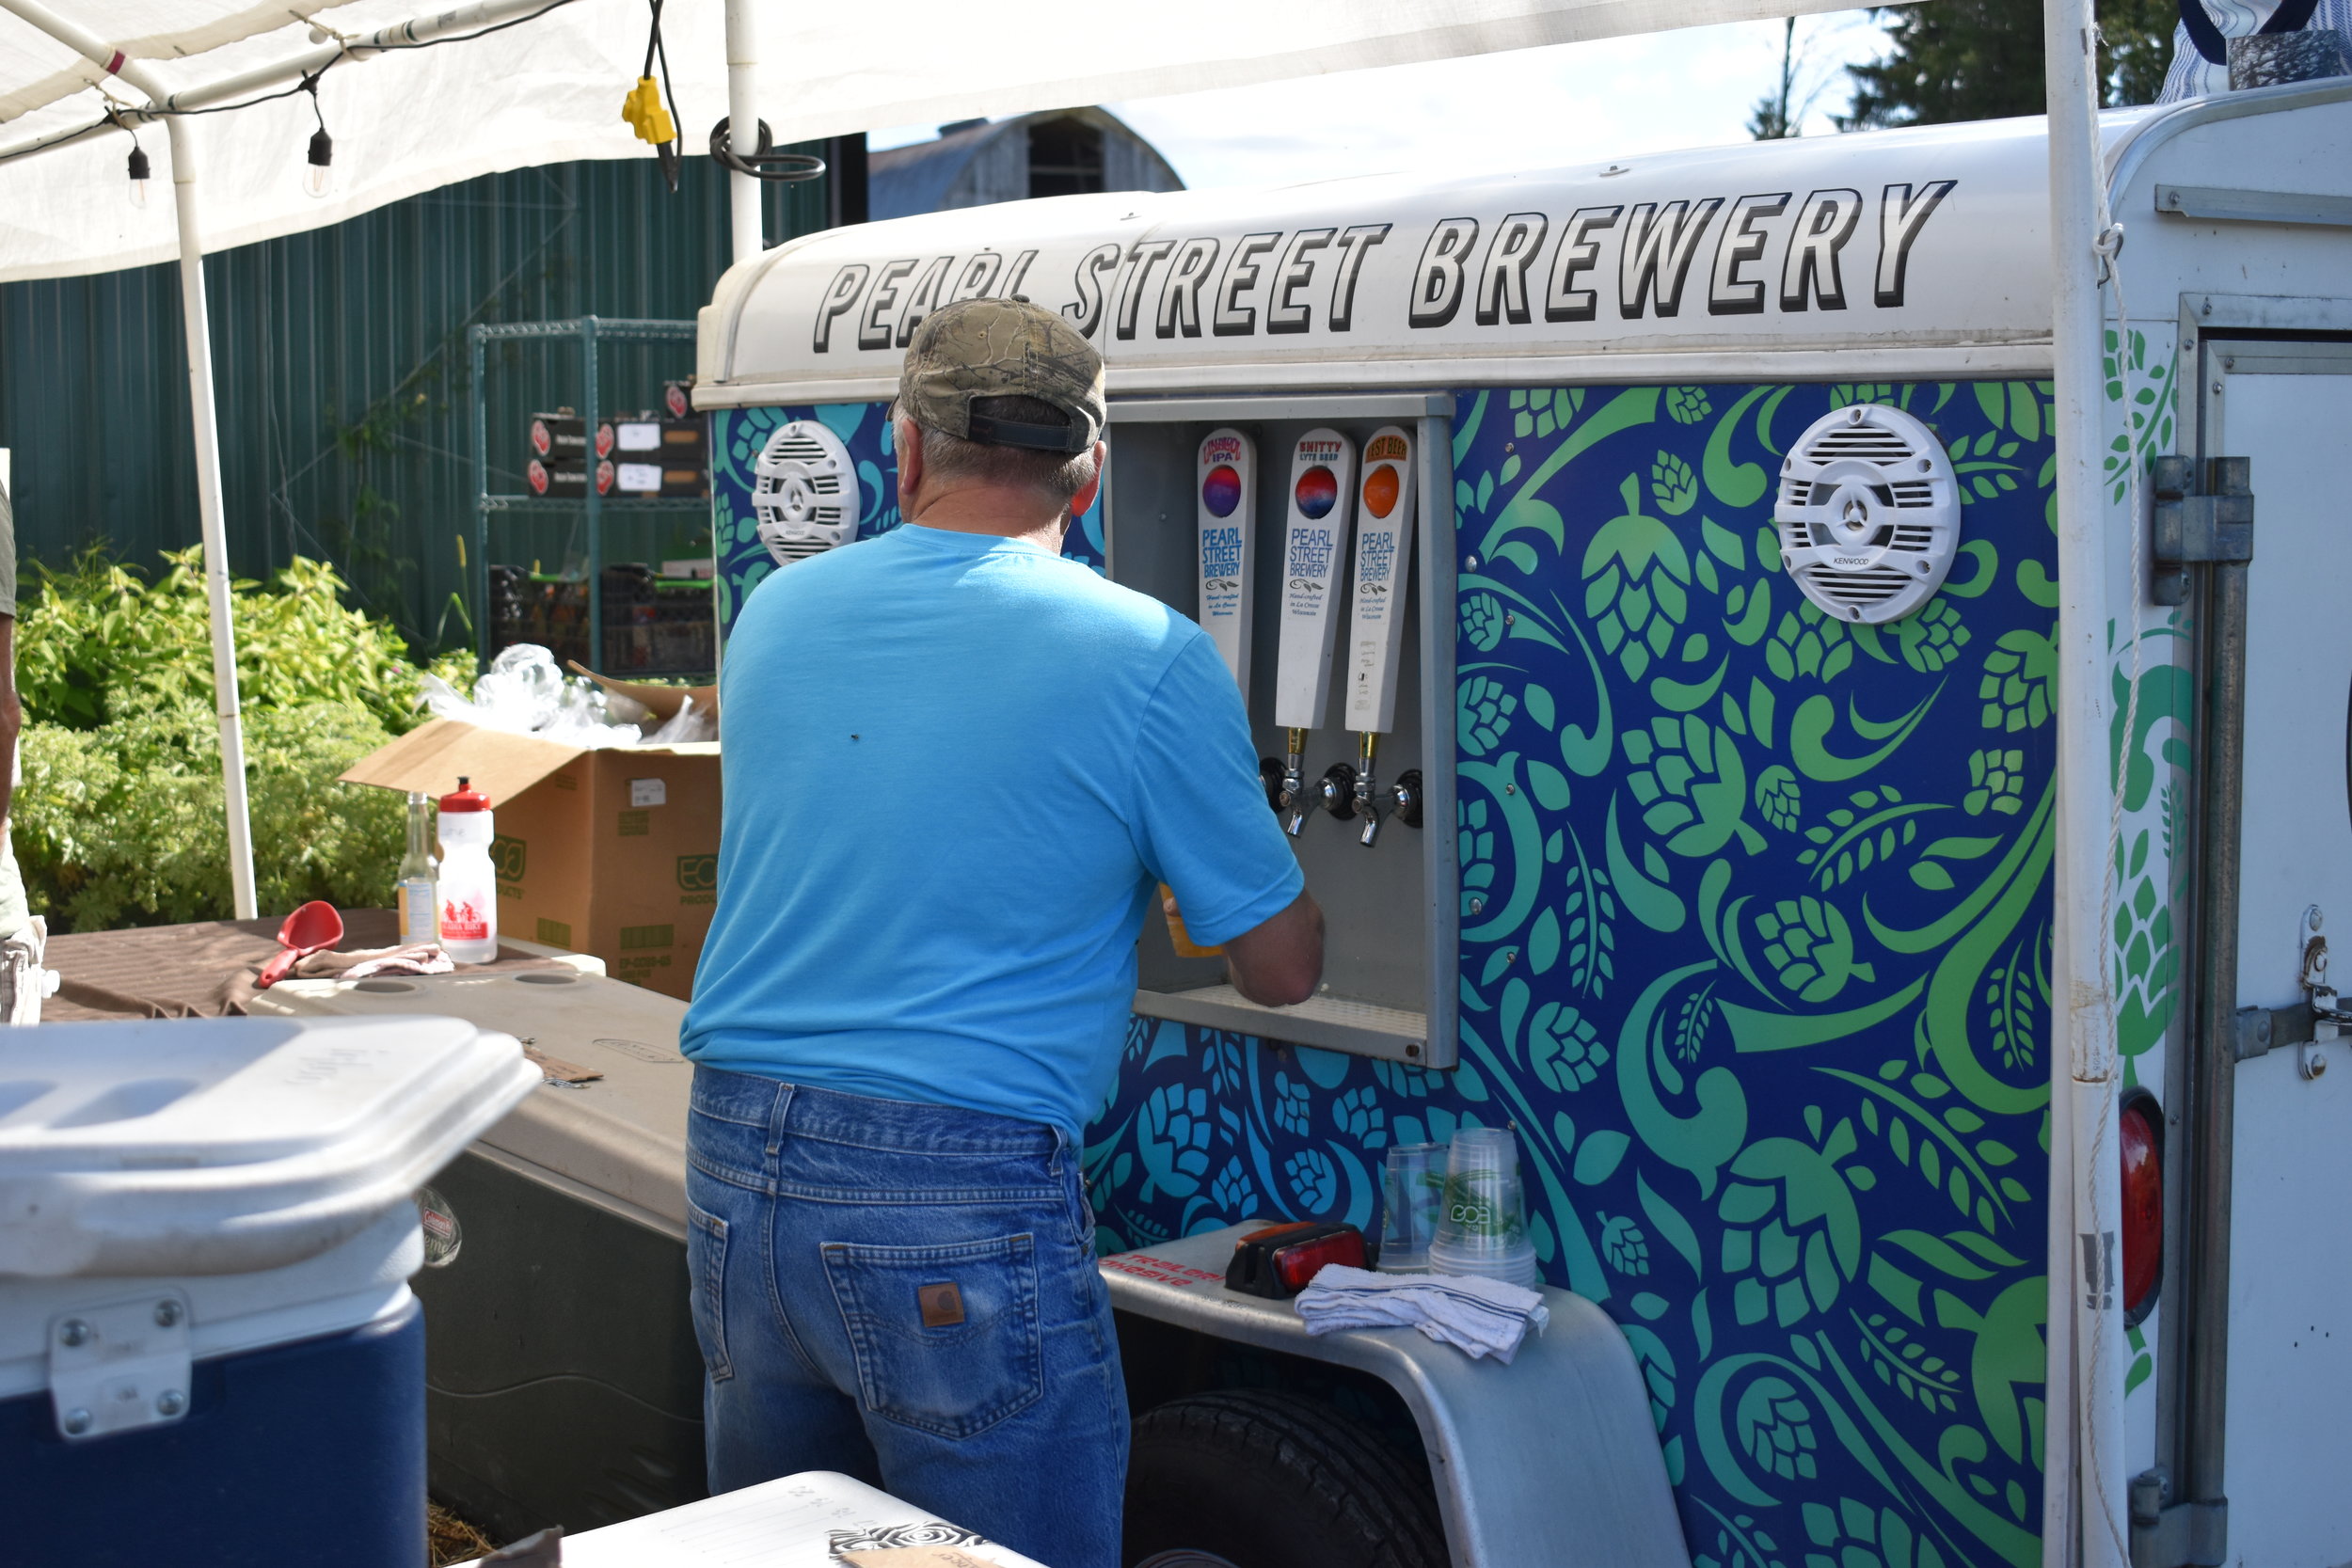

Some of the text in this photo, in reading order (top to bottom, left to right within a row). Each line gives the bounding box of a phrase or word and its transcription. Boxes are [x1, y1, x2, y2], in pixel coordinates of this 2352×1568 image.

[1061, 222, 1392, 341] STREET
[1408, 180, 1958, 328] BREWERY
[1299, 440, 1343, 452] SHITTY
[1213, 452, 1232, 462] IPA
[1202, 527, 1242, 546] PEARL
[1291, 529, 1333, 547] PEARL
[1361, 531, 1394, 550] PEARL
[1202, 545, 1242, 563] STREET
[1290, 546, 1332, 563] STREET
[1360, 548, 1394, 567] STREET
[1834, 557, 1869, 565] KENWOOD
[1203, 562, 1240, 578] BREWERY
[1289, 563, 1328, 578] BREWERY
[1359, 566, 1391, 581] BREWERY
[679, 857, 718, 890] EC
